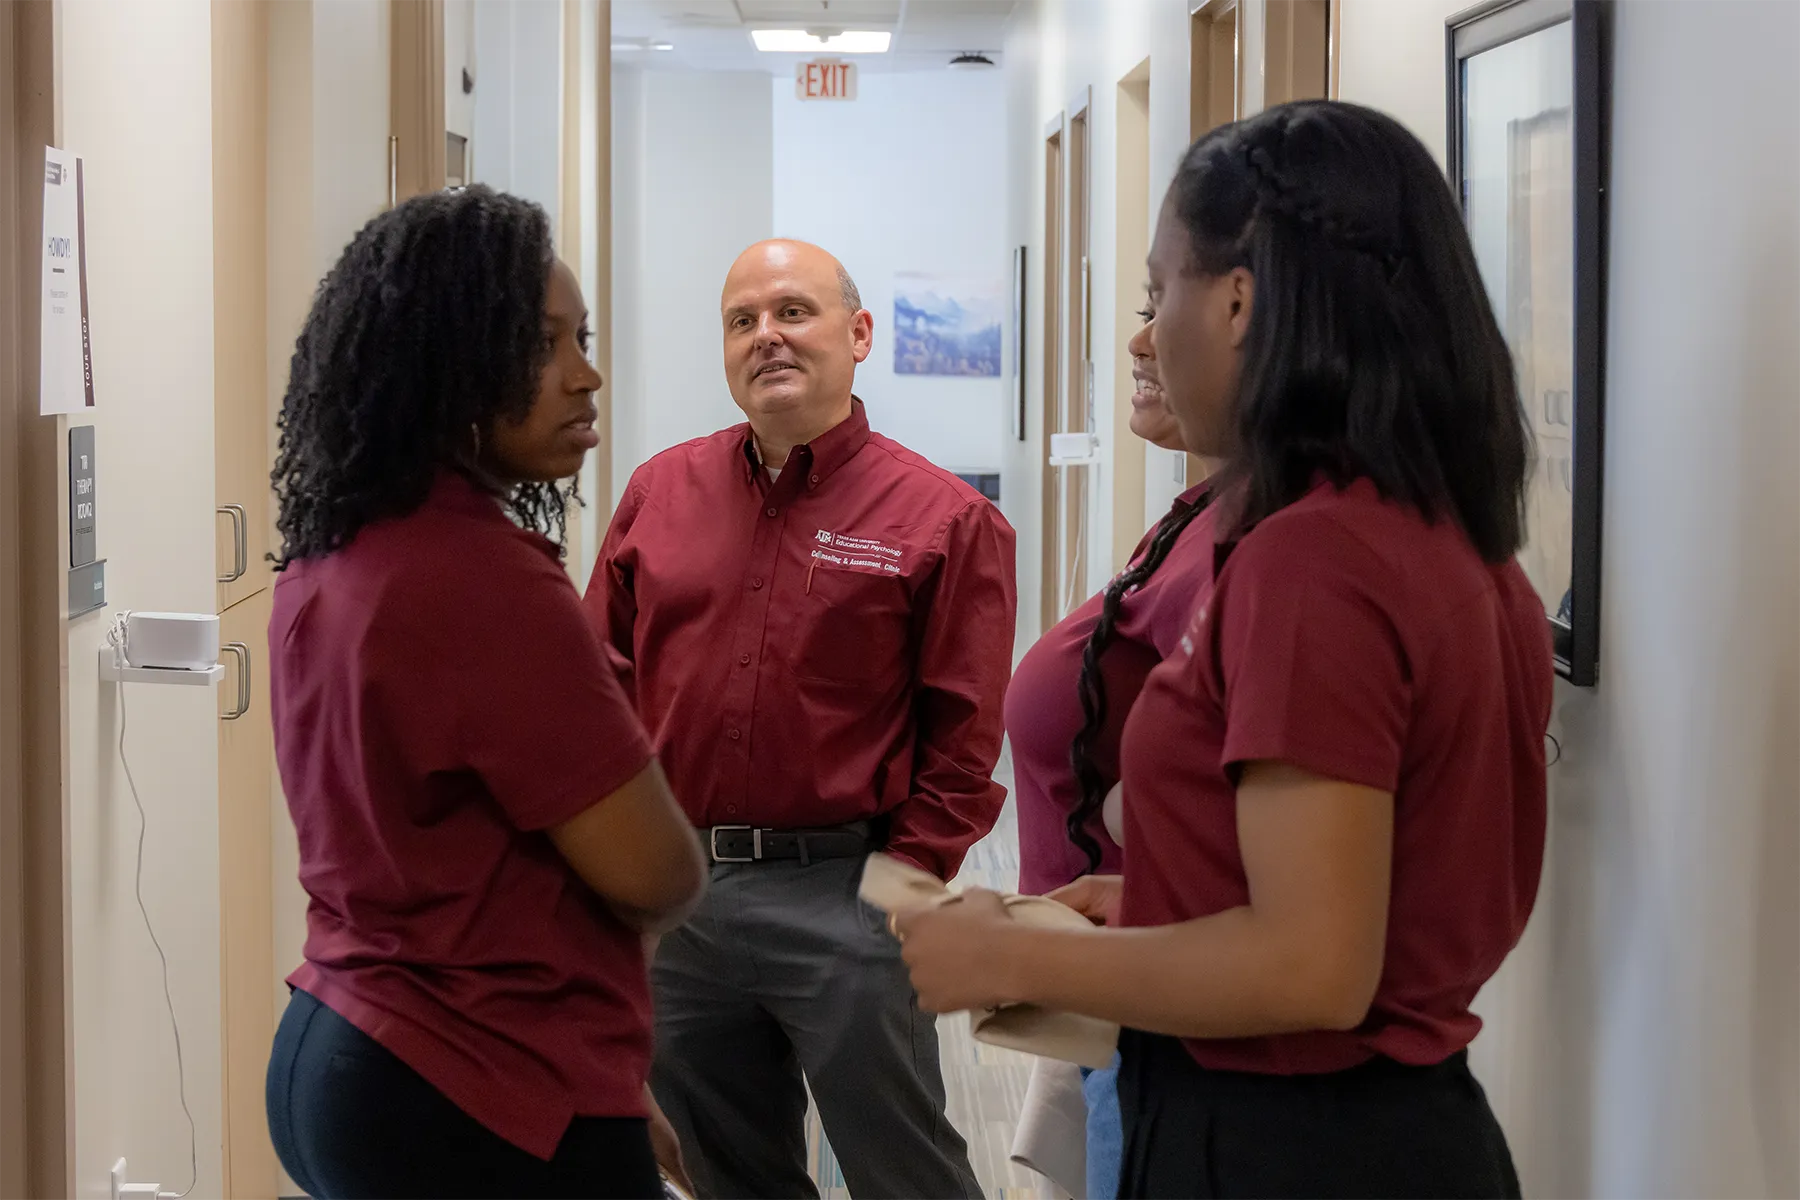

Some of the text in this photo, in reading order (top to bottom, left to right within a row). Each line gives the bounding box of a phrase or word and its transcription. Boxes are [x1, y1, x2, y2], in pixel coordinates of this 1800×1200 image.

[806, 64, 849, 97] EXIT
[47, 236, 71, 258] HOWDY!
[836, 540, 870, 549] Educational
[871, 545, 903, 557] Psychology
[843, 557, 849, 565] &
[849, 559, 882, 569] Assessment
[884, 563, 901, 573] Clinic
